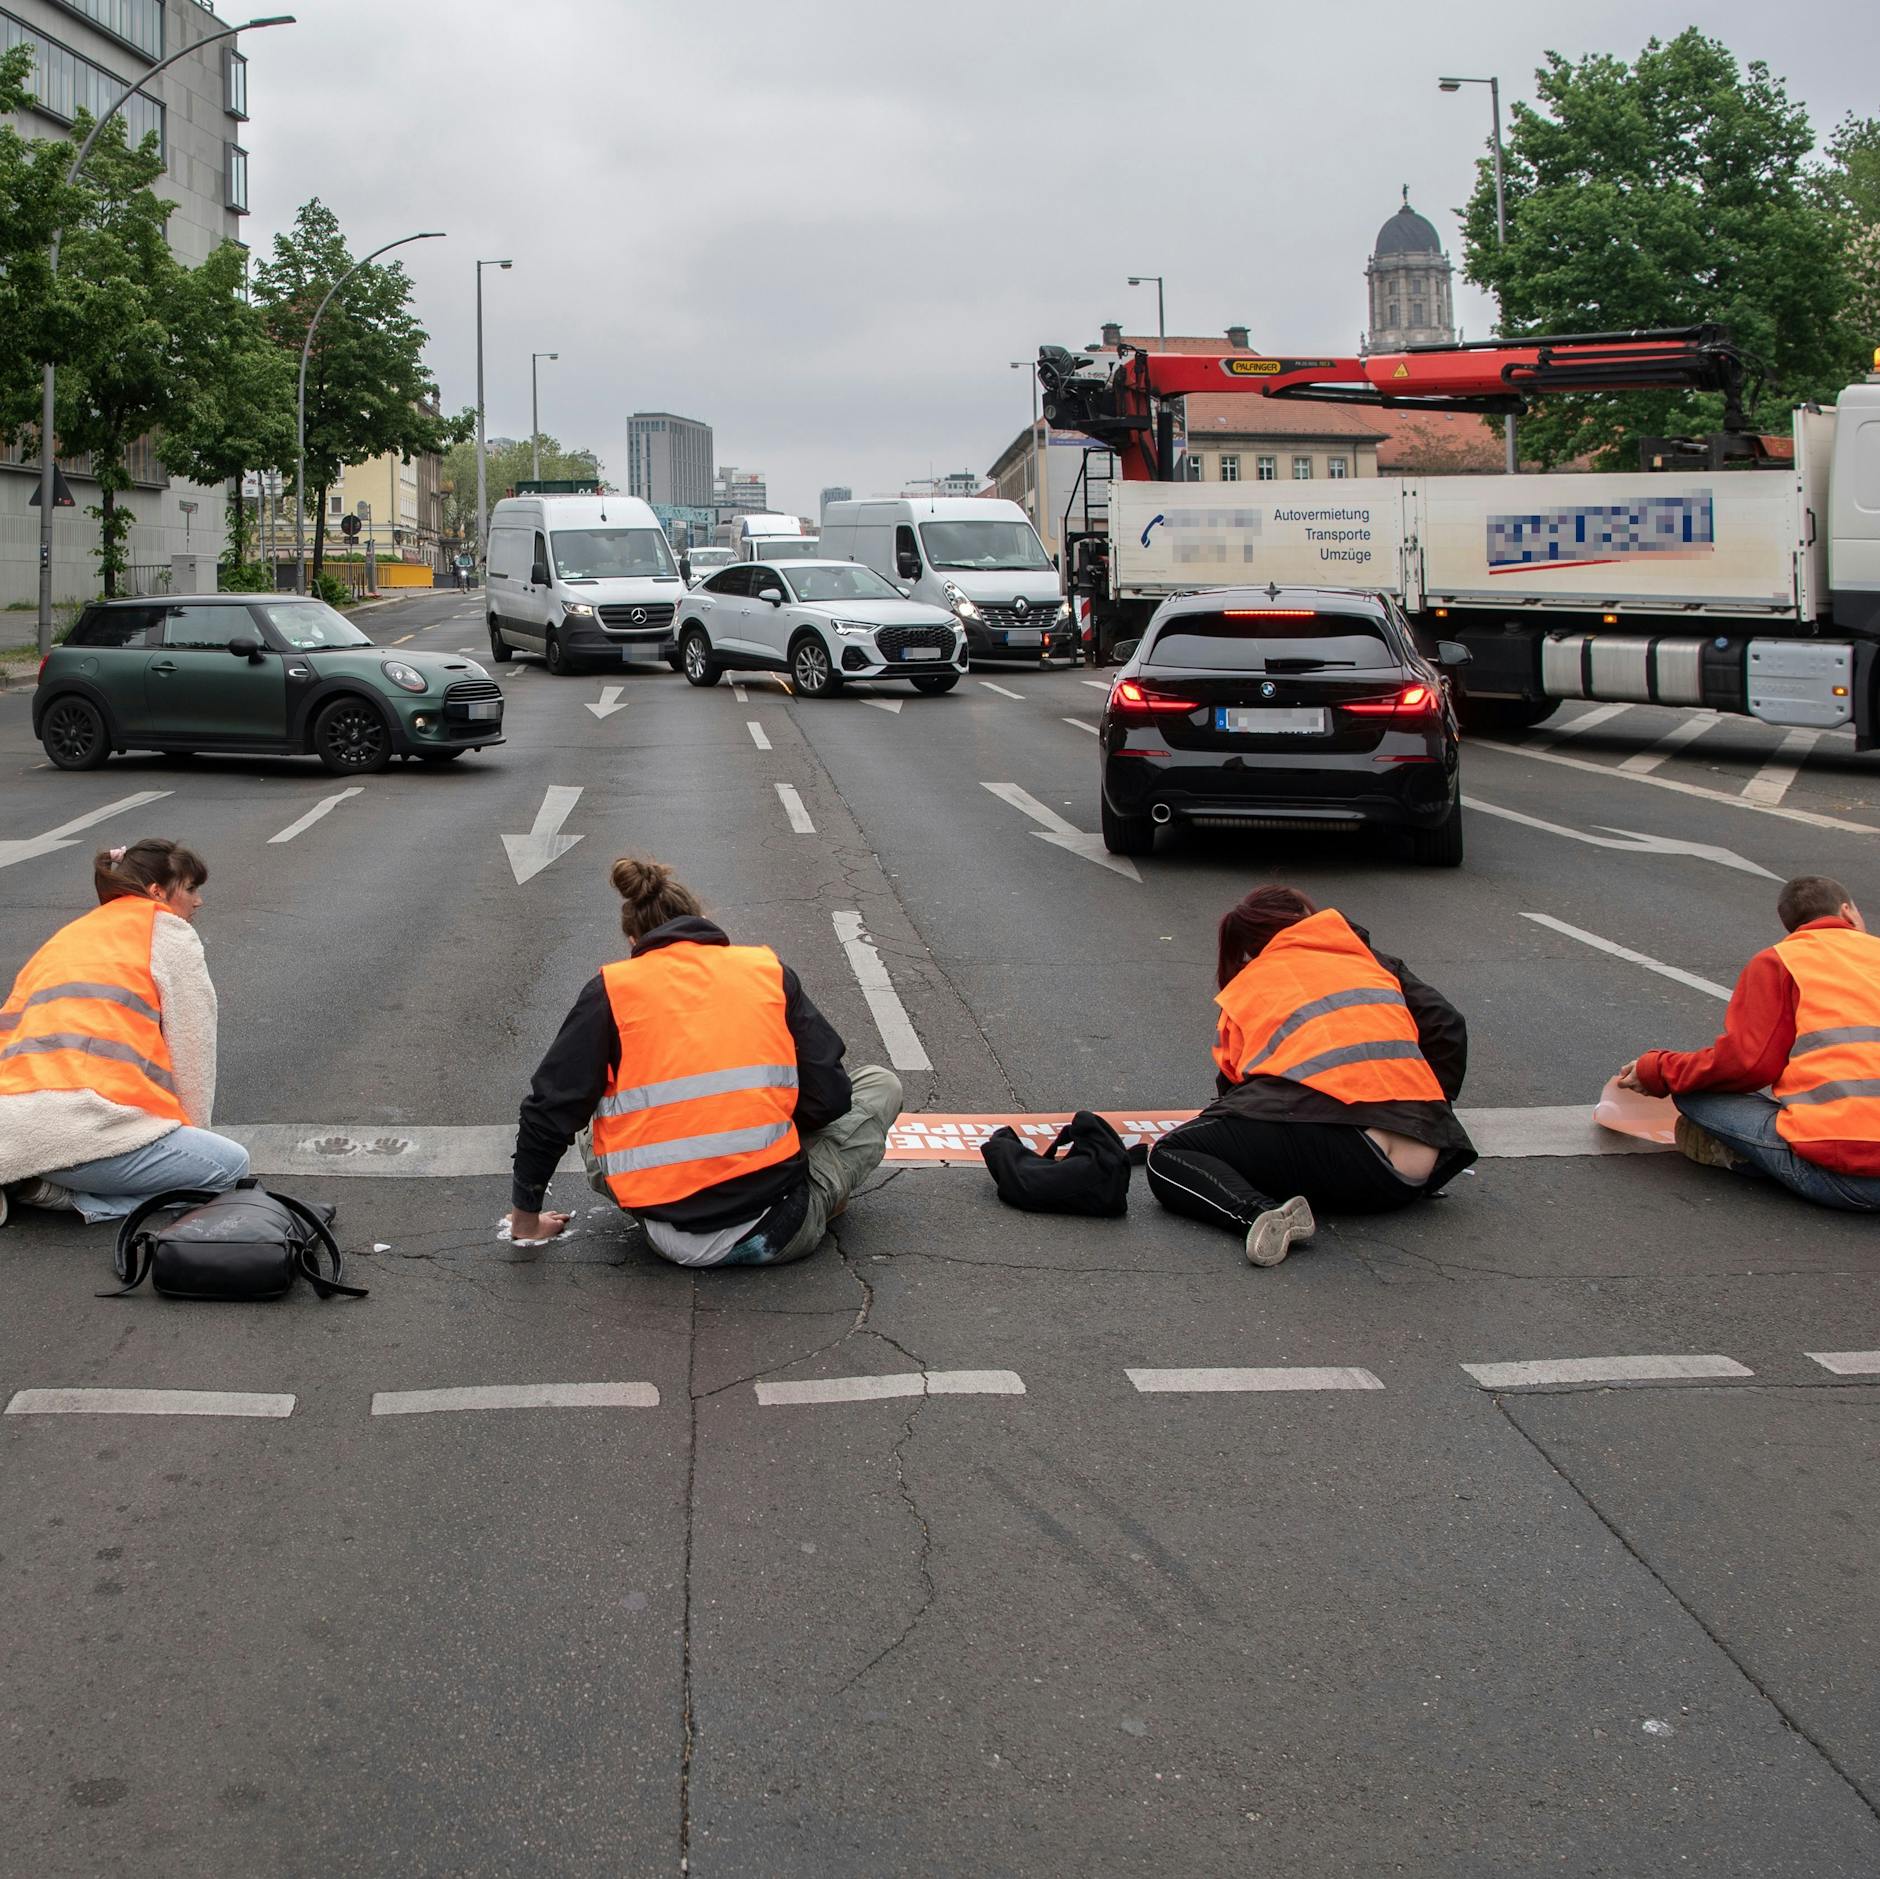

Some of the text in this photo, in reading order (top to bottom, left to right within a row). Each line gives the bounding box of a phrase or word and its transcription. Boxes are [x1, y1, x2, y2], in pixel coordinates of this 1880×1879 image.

[1235, 362, 1278, 372] PALFINGER
[1274, 508, 1370, 523] Autovermietung
[1305, 528, 1371, 543] Transporte
[1320, 548, 1371, 564] Umzüge
[887, 1122, 1006, 1135] KIPP
